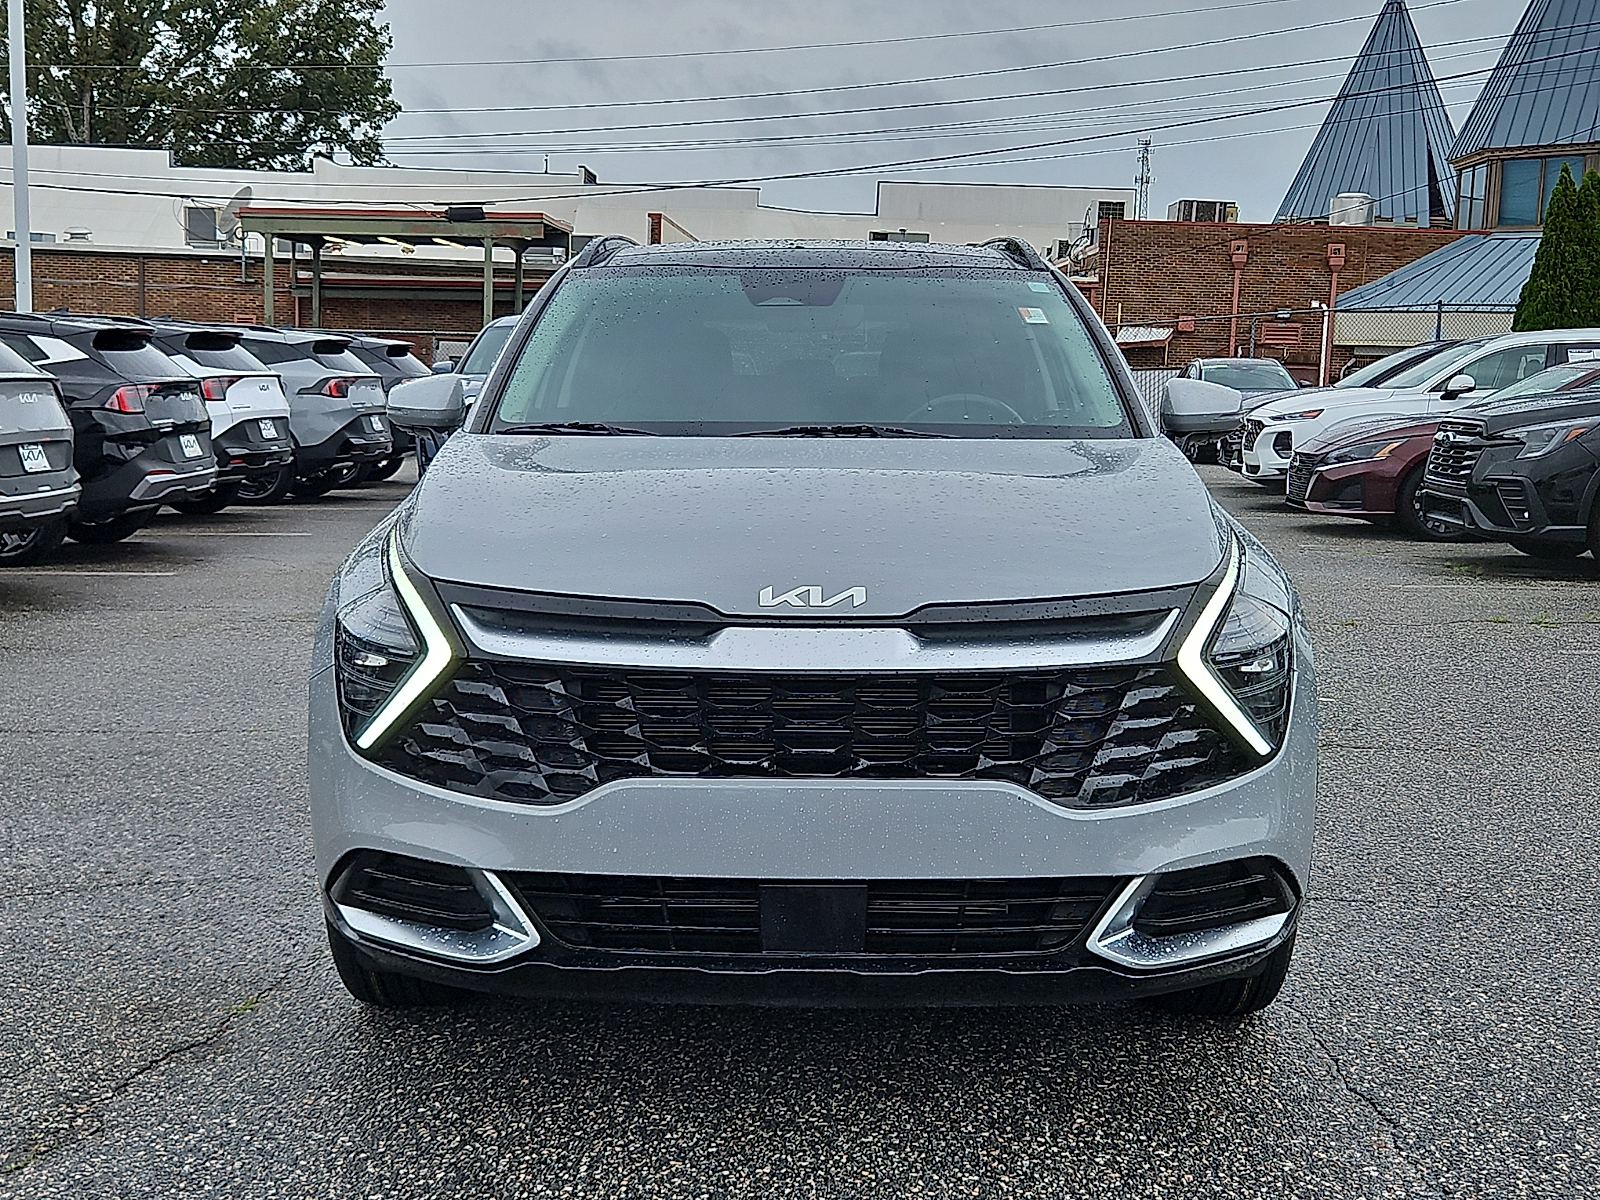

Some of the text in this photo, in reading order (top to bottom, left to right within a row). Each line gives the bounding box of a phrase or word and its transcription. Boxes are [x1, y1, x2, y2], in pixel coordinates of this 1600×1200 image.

[19, 393, 38, 404] KIA
[22, 450, 44, 462] KIA
[759, 585, 867, 608] KIA
